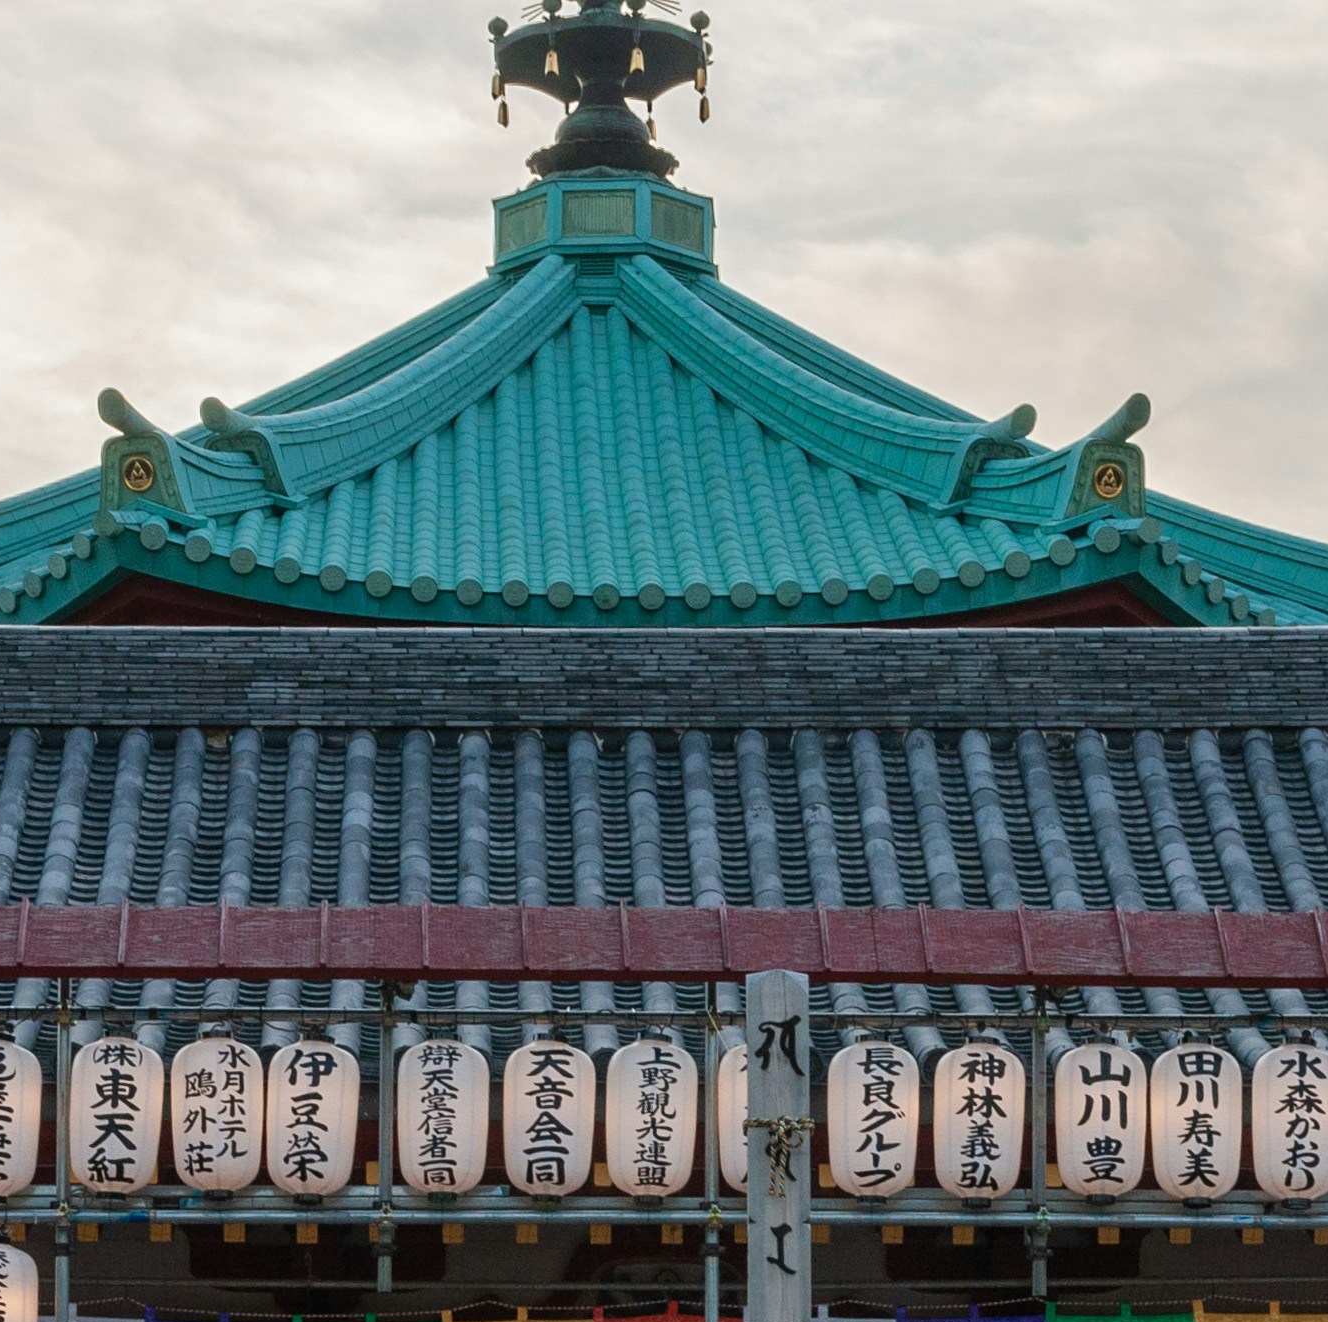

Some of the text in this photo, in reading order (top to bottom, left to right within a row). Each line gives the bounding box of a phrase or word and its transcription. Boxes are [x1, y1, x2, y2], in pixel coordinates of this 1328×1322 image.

[89, 1044, 143, 1184] (株)東天紅
[217, 1045, 251, 1159] 水月ホテル
[523, 1049, 574, 1186] 天音会一同
[634, 1047, 681, 1187] 上野観光連盟
[853, 1047, 906, 1188] 長良グループ
[955, 1052, 1007, 1191] 神林義弘
[1077, 1050, 1132, 1184] 山川豊
[1176, 1051, 1223, 1188] 田川寿美
[1274, 1051, 1327, 1191] 水森かおり
